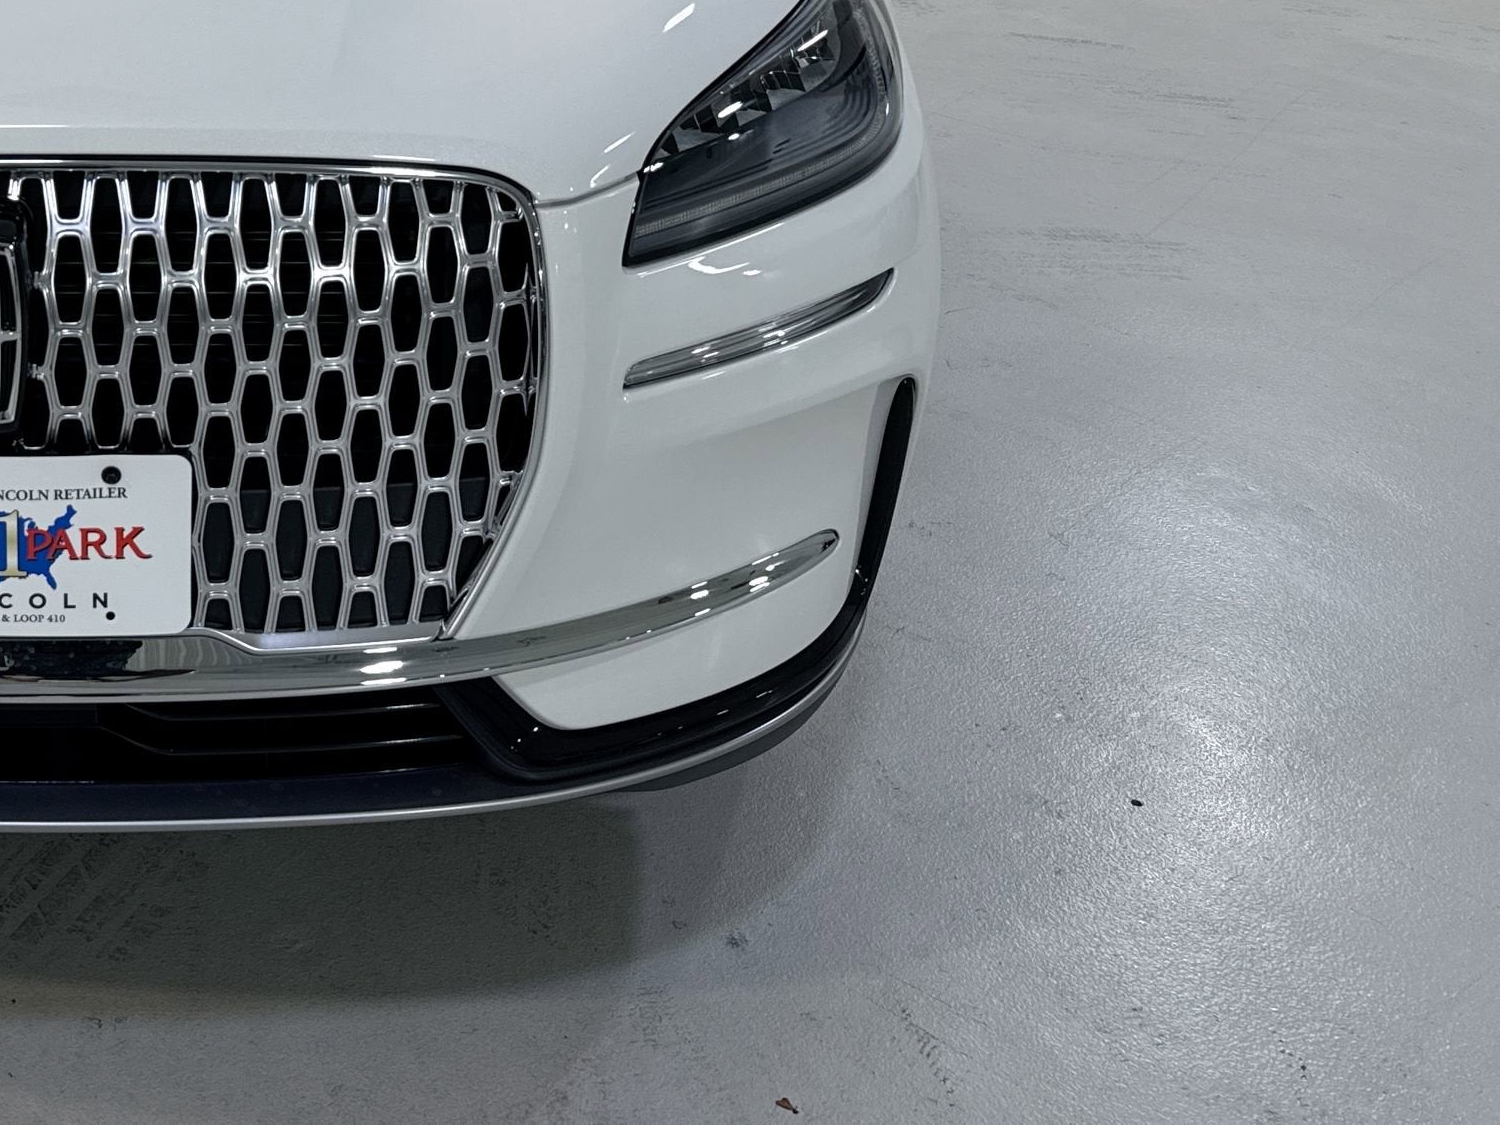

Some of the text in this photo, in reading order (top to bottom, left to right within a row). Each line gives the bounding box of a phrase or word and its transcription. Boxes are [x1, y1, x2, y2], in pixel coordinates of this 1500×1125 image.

[53, 486, 128, 500] RETAILER
[27, 525, 153, 561] PARK
[1, 613, 11, 623] &
[13, 613, 45, 623] LOOP
[47, 613, 66, 624] 410
